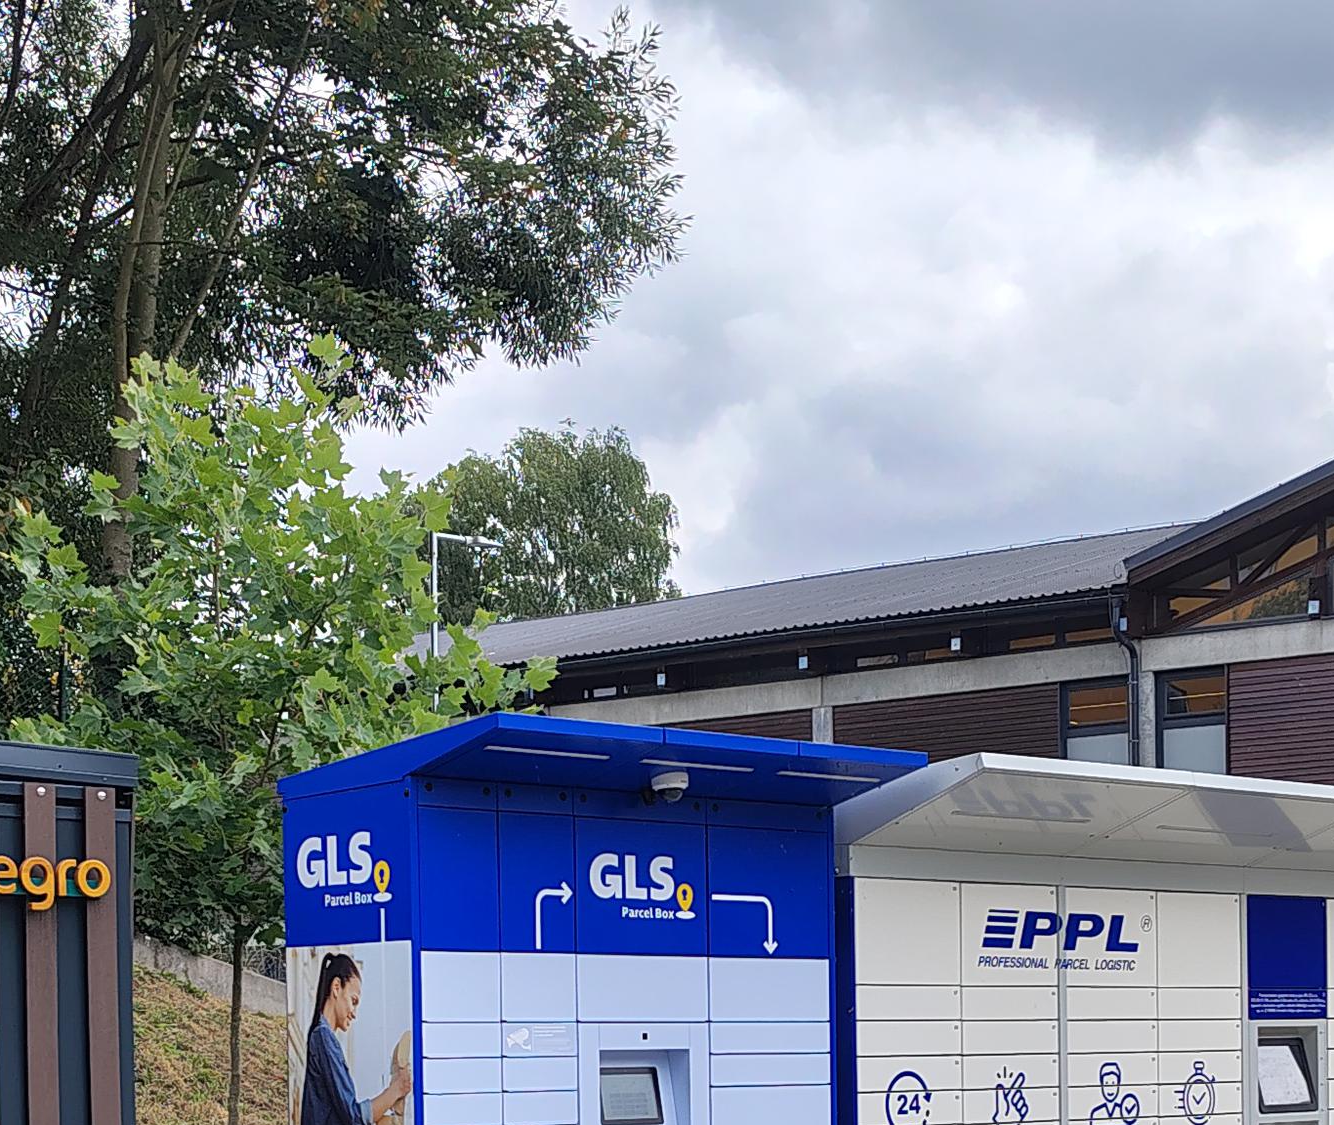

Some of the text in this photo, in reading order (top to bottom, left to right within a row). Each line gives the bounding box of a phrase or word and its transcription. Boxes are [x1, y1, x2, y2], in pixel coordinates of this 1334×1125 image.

[297, 831, 372, 888] GLS
[589, 853, 675, 901] GLS
[324, 891, 373, 907] Parcel Box
[622, 906, 674, 919] Parcel Box
[978, 956, 1136, 972] PROFESSIONAL PARCEL LOGISTIC
[897, 1094, 921, 1115] 24
